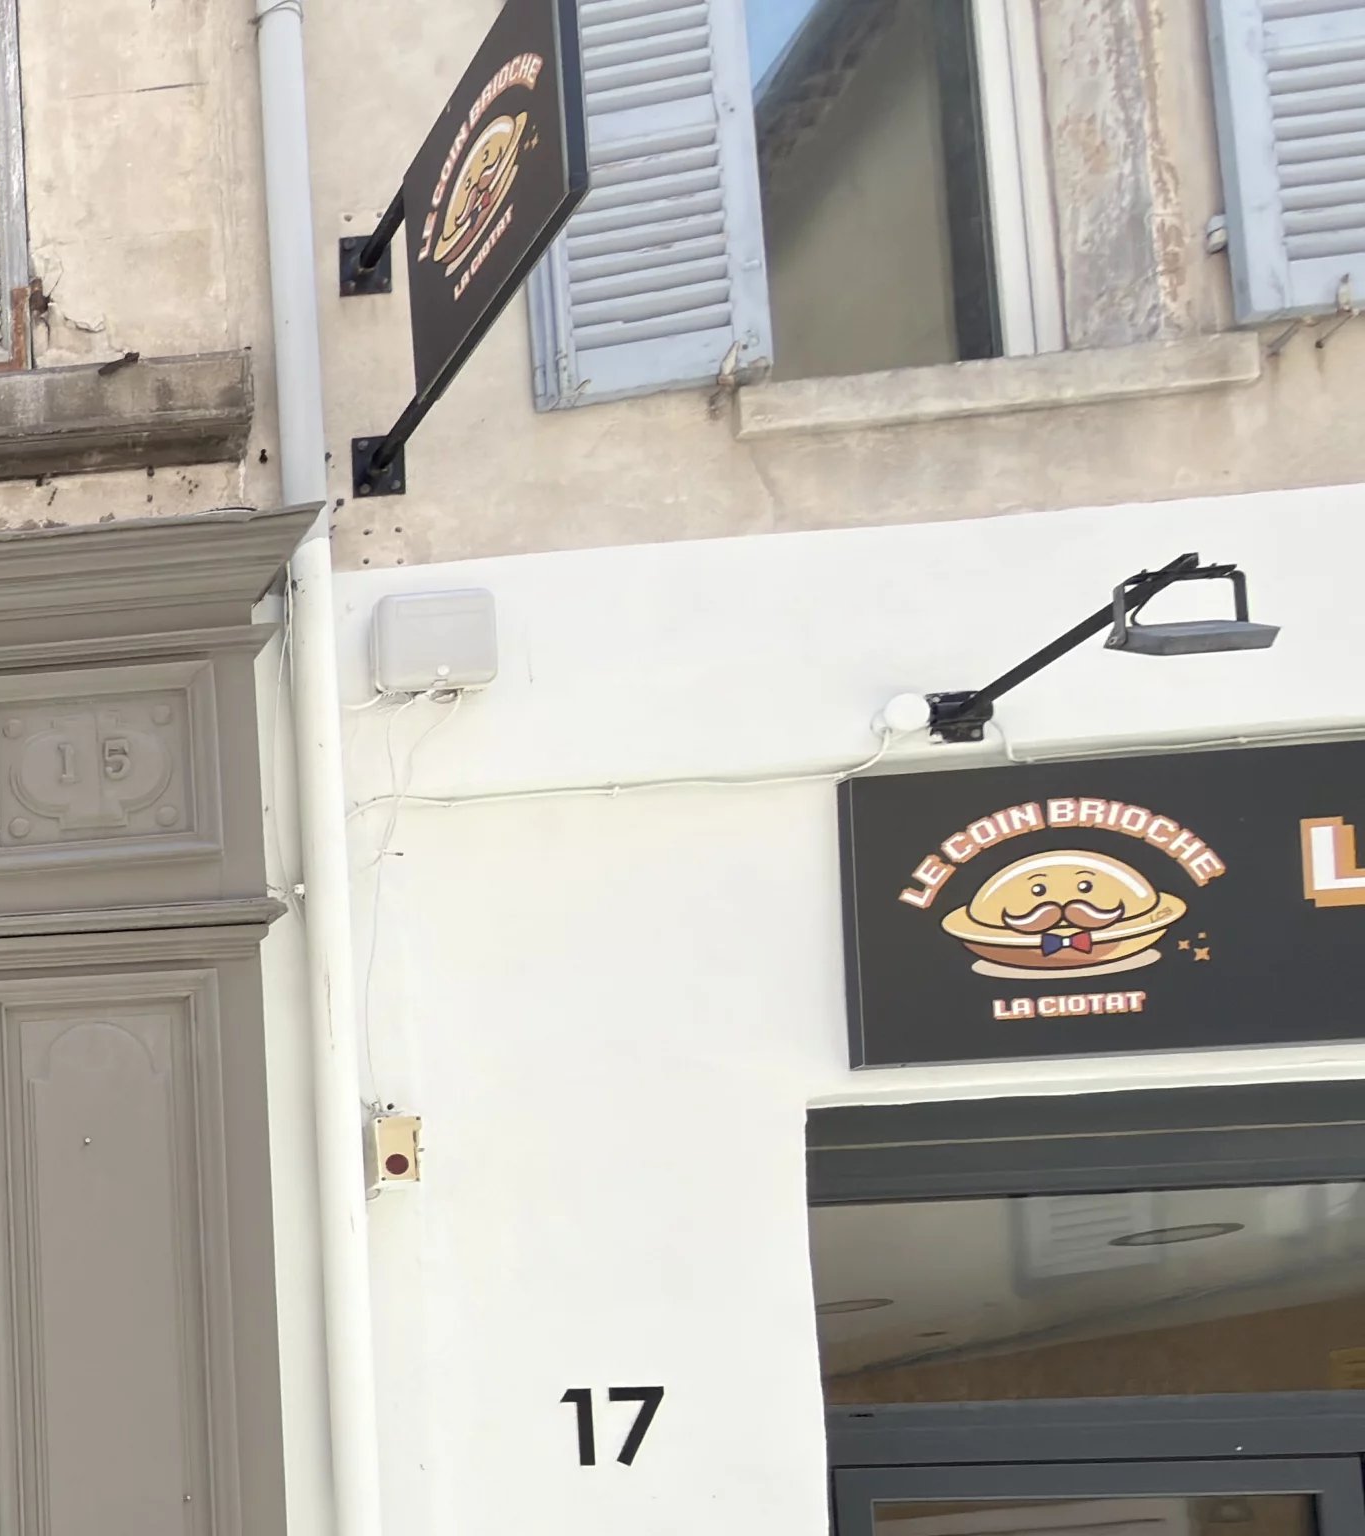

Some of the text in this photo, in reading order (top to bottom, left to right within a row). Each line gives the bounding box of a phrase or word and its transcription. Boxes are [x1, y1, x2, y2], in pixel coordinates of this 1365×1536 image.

[418, 53, 544, 262] LE COIN BRIOCHE
[454, 203, 514, 301] LA CIOTAT
[57, 738, 130, 783] 15
[899, 798, 1226, 908] LE COIN BRIOCHE
[993, 991, 1146, 1020] LA CIOTAT
[560, 1386, 664, 1467] 17
